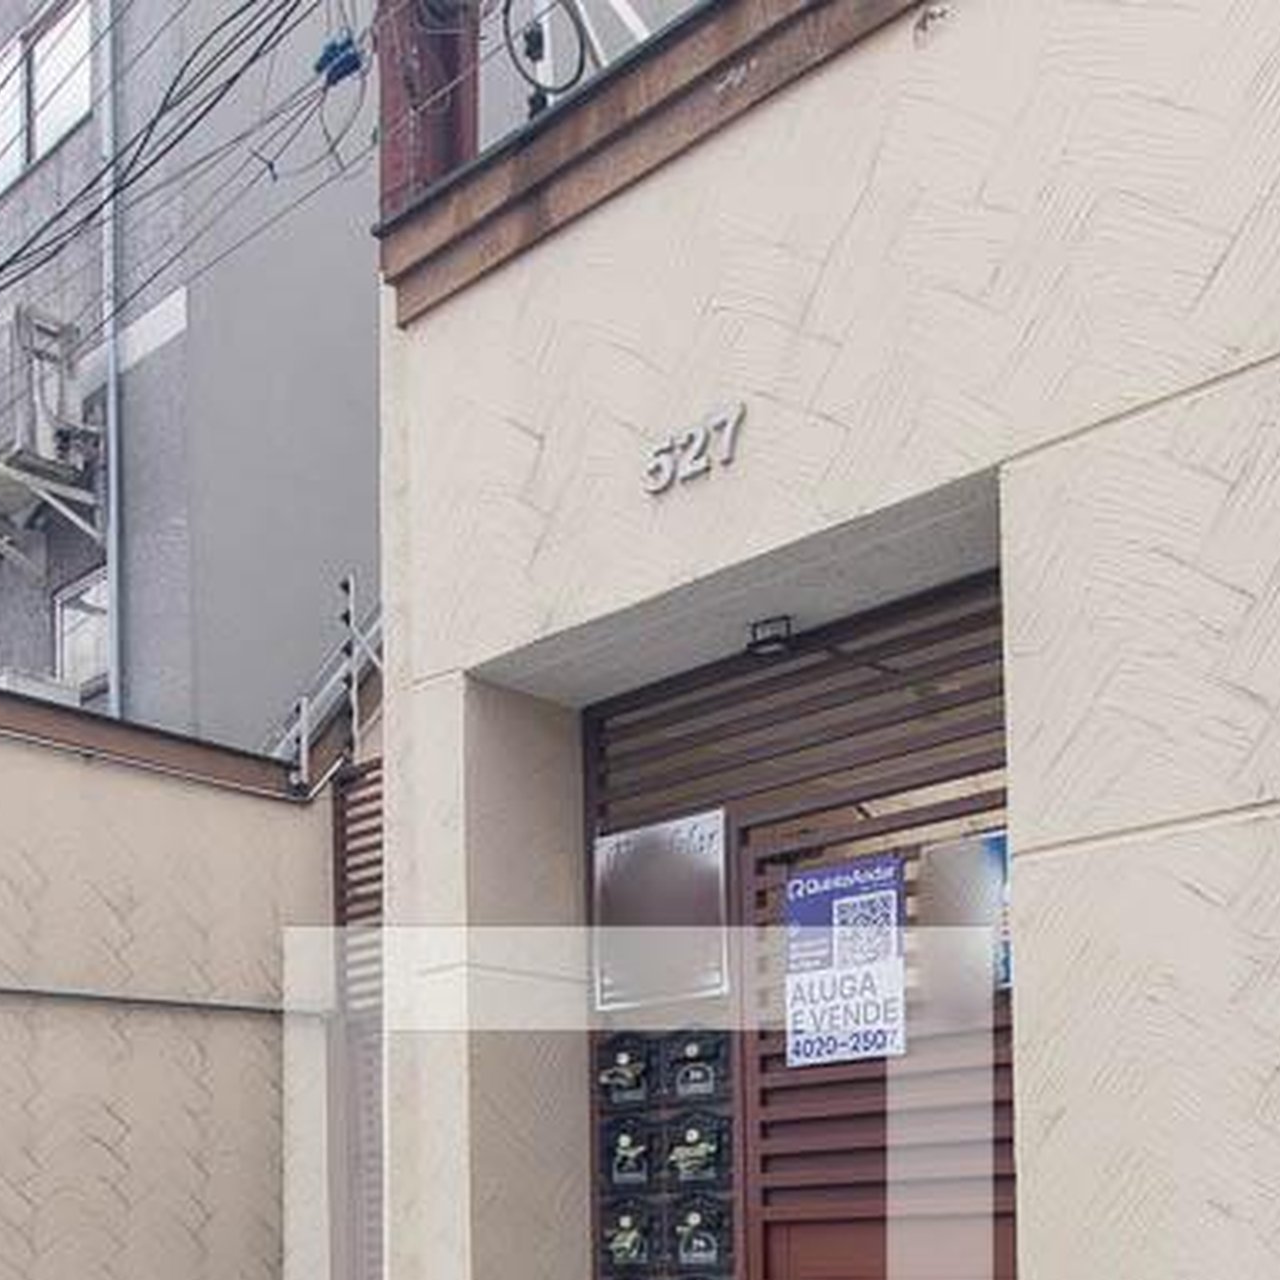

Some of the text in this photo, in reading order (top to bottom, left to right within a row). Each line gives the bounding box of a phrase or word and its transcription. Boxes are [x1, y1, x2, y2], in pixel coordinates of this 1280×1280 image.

[642, 401, 747, 496] 527
[791, 972, 877, 1008] ALUGA
[792, 999, 899, 1034] E VENDE
